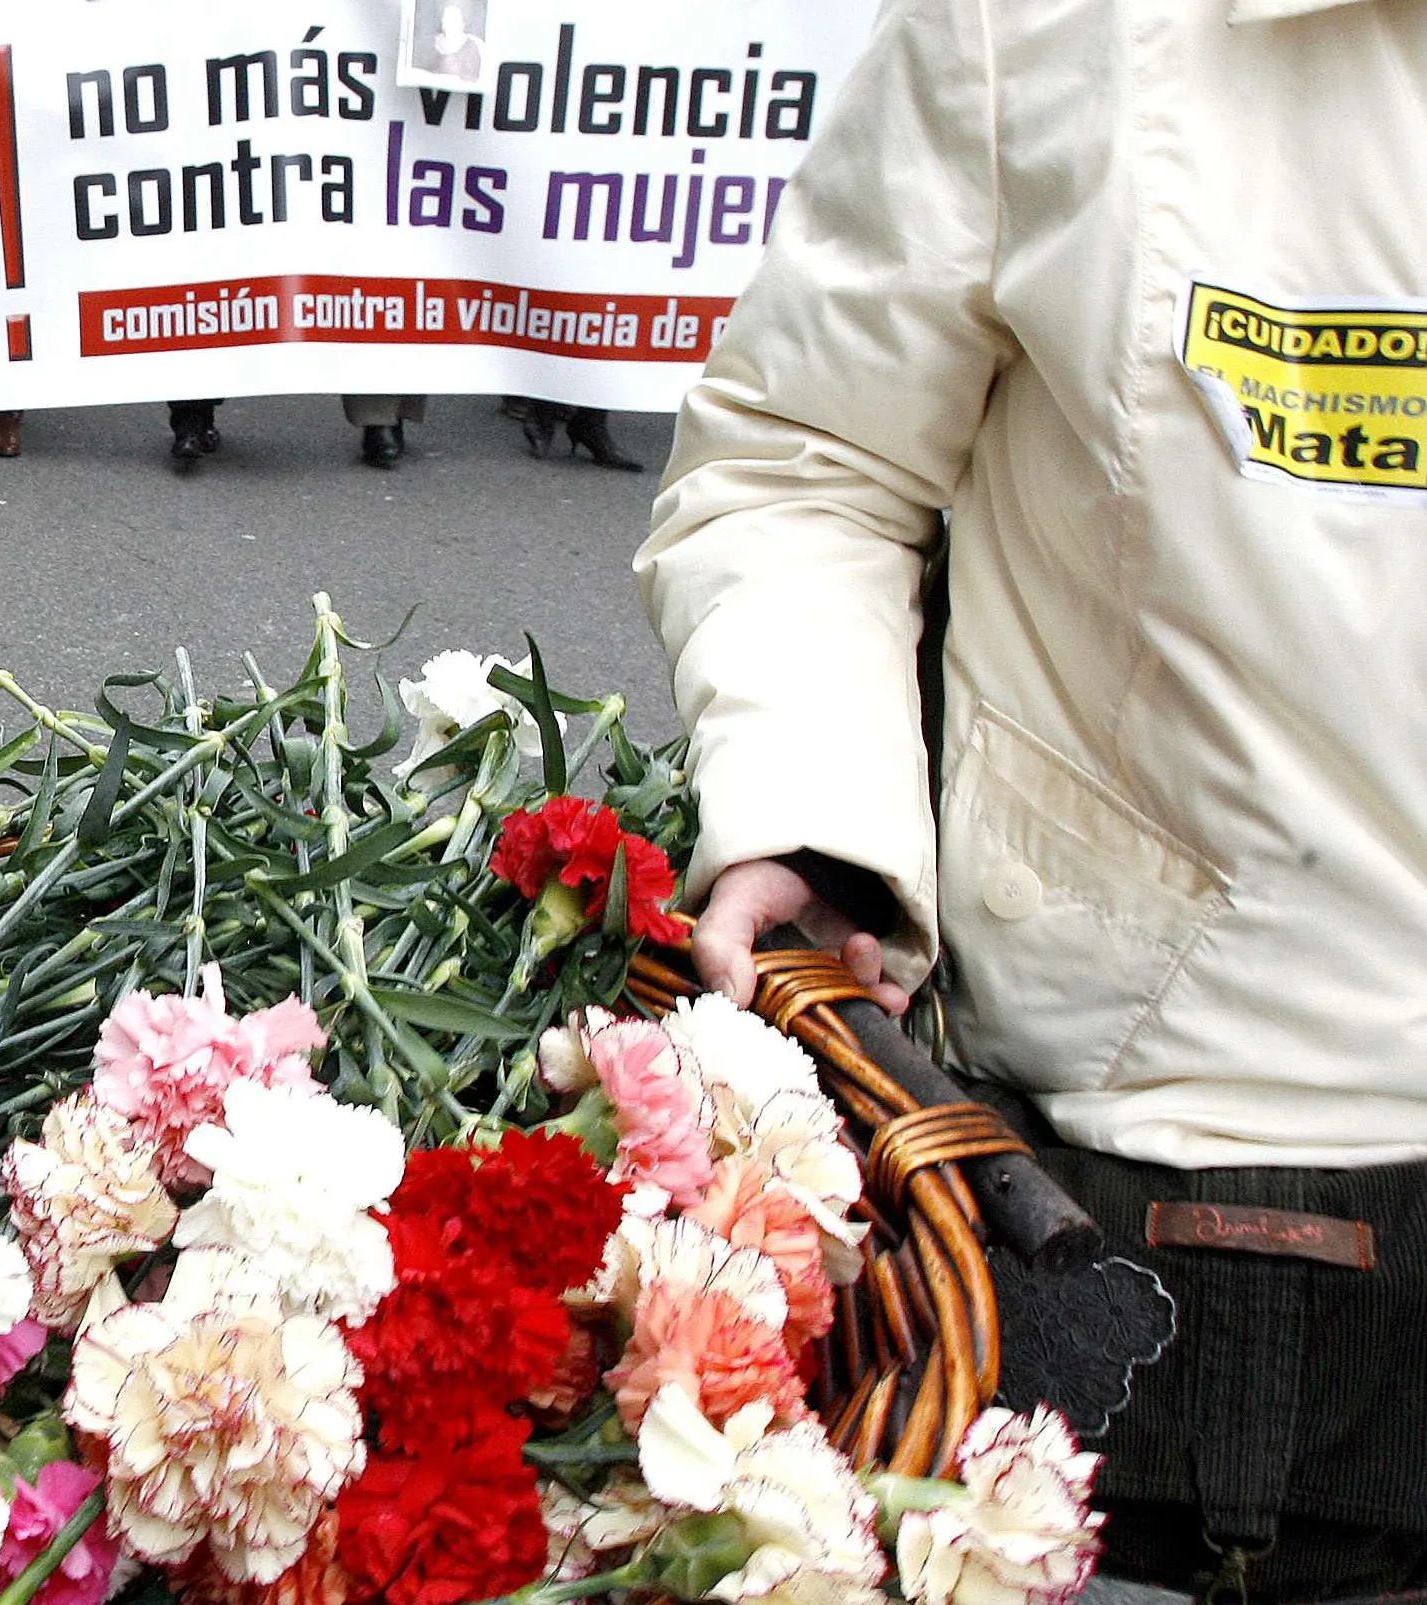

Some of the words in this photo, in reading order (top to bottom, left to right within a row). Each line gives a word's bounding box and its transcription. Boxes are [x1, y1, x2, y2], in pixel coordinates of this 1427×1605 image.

[66, 63, 170, 139] no
[205, 25, 378, 126] más
[73, 138, 354, 241] contra
[385, 120, 508, 234] las
[102, 286, 279, 342] comisión
[292, 287, 405, 331] contra
[415, 280, 446, 331] la
[456, 288, 640, 348] violencia
[649, 298, 700, 349] de
[1240, 375, 1427, 418] MACHISMO
[1244, 404, 1419, 472] Mata
